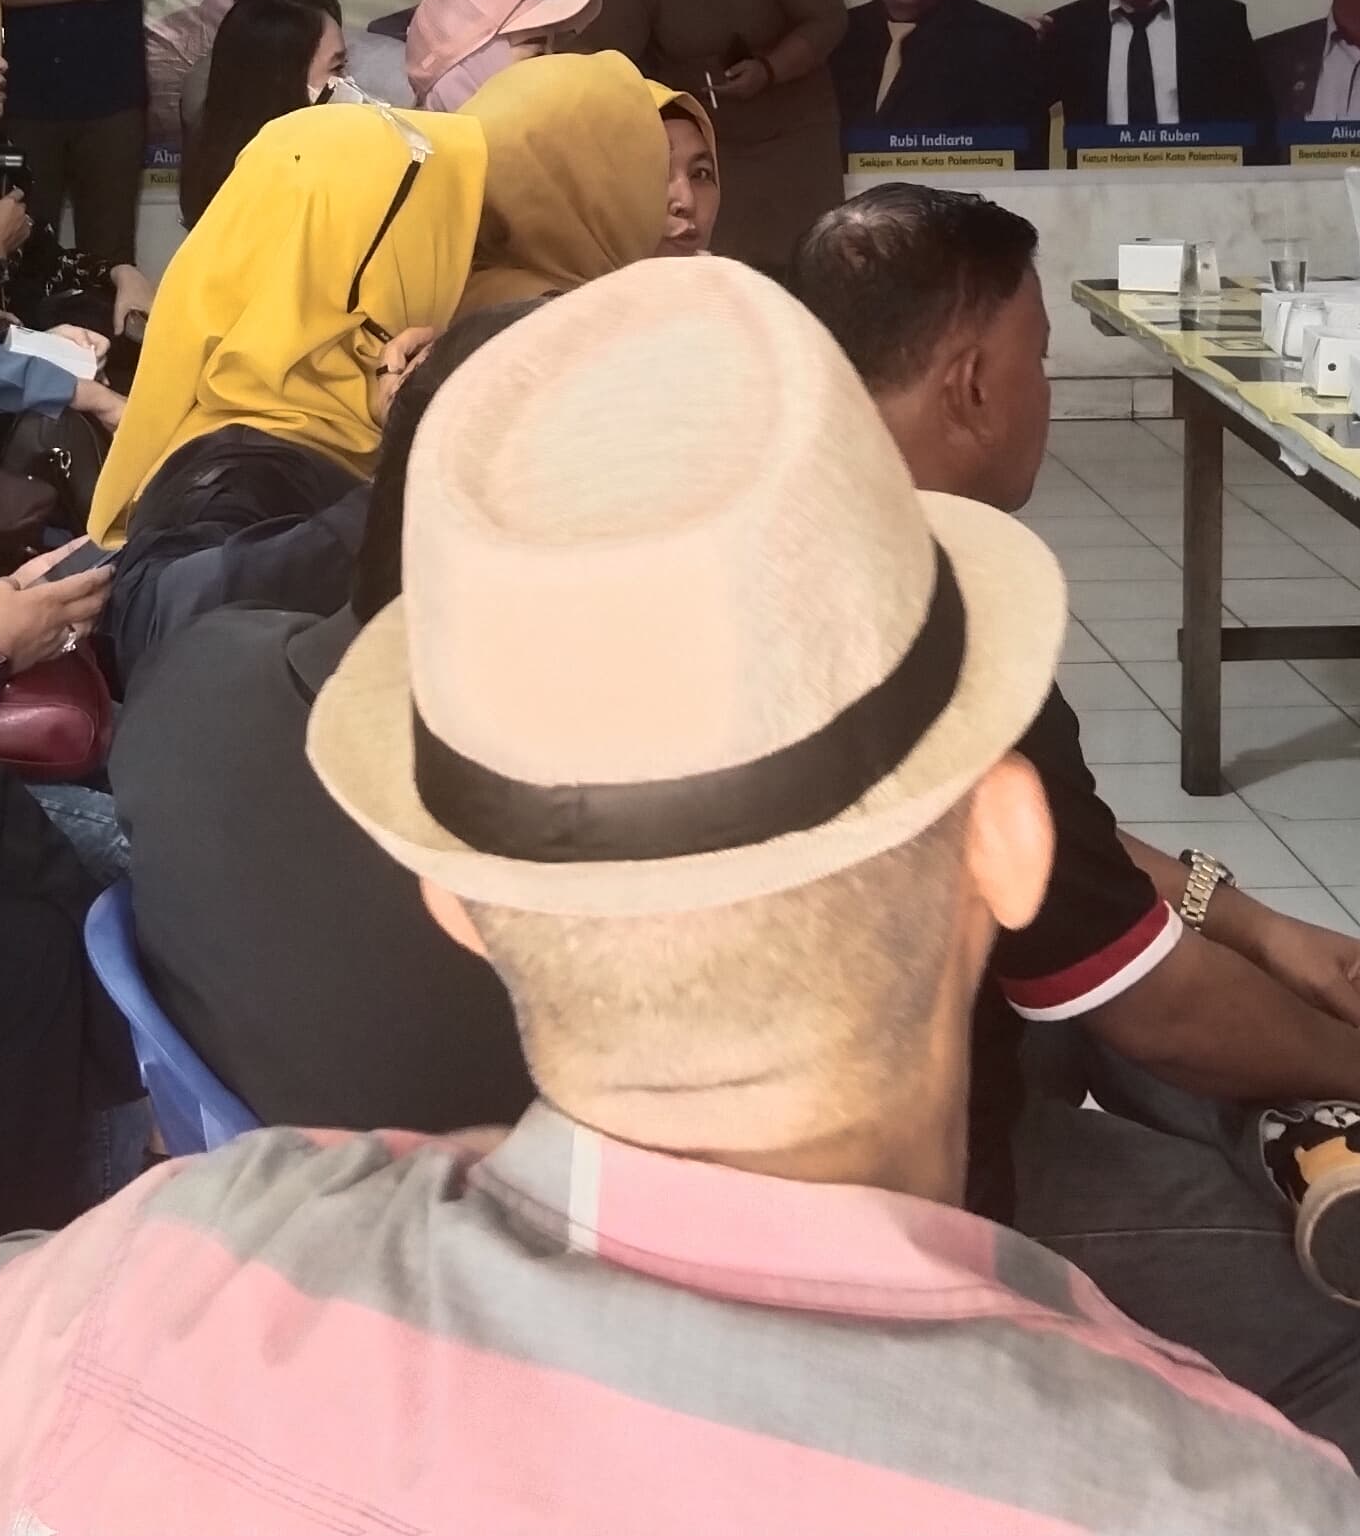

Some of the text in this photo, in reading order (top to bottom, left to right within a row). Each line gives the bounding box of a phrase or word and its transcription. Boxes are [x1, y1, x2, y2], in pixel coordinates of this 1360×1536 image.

[890, 133, 973, 147] Rubi Indiarta
[1119, 129, 1200, 143] M. Ali Ruben
[921, 157, 944, 166] Kota
[948, 155, 1003, 167] Palembang
[1165, 152, 1186, 161] Kota
[1190, 151, 1238, 162] Palembang
